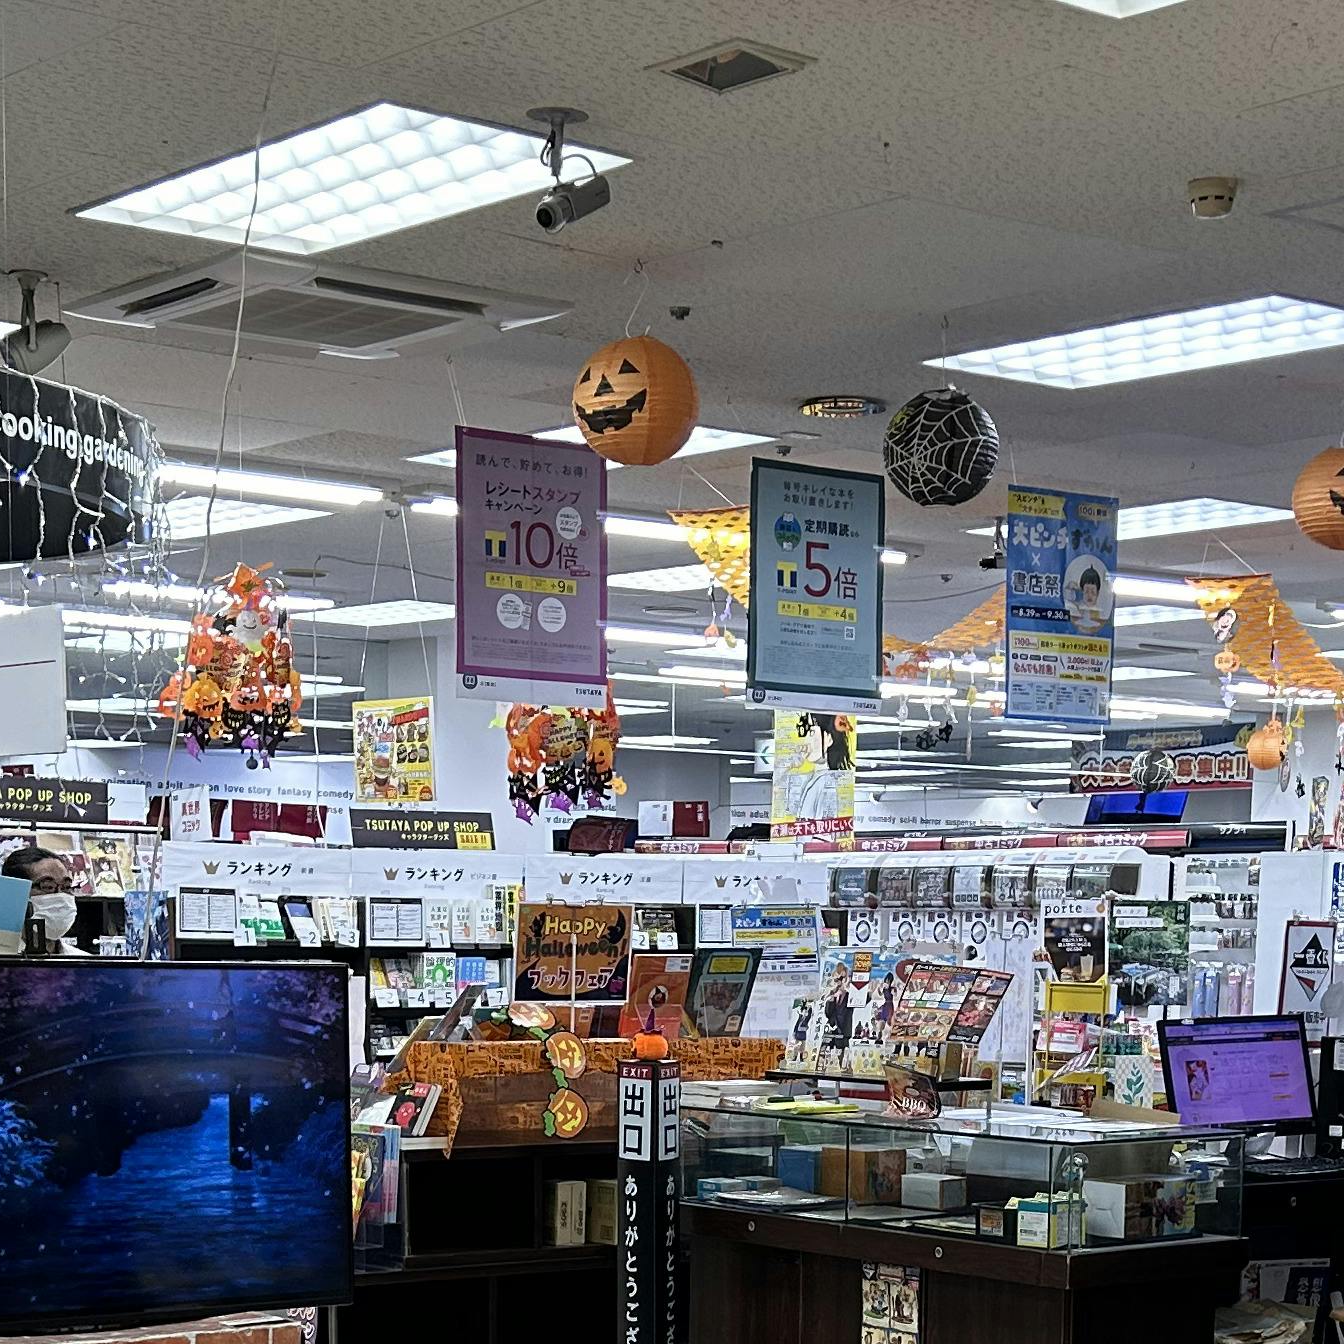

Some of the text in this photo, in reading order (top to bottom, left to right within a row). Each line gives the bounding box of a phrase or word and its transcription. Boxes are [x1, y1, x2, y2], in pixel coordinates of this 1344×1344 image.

[486, 481, 582, 505] レシートスタンプ
[485, 498, 543, 515] キャンペーン
[804, 541, 858, 600] 5倍
[1081, 754, 1248, 788] 大会参募集中!!
[8, 787, 34, 803] POP
[37, 789, 54, 802] UP
[58, 790, 93, 806] SHOP
[224, 784, 245, 794] love
[248, 785, 272, 797] story
[277, 786, 312, 799] fantasy
[317, 789, 355, 801] comedy
[365, 819, 479, 833] TSUTAYA POP UP SHOP
[770, 817, 854, 838] 成瀬は天下を取りにいく
[401, 833, 450, 842] キャラクターグッズ
[459, 834, 479, 844] SALE
[861, 839, 908, 853] 中古コミック
[226, 860, 293, 877] ランキング
[405, 867, 465, 882] ランキング
[578, 872, 634, 886] ランキング
[1044, 903, 1083, 916] porte
[544, 914, 607, 939] Happy
[528, 965, 615, 991] ブックフェア
[623, 1067, 649, 1078] EXIT
[660, 1066, 679, 1078] EXIT
[901, 1098, 926, 1111] BBQ
[623, 1082, 645, 1157] 出口
[663, 1082, 679, 1155] 出口
